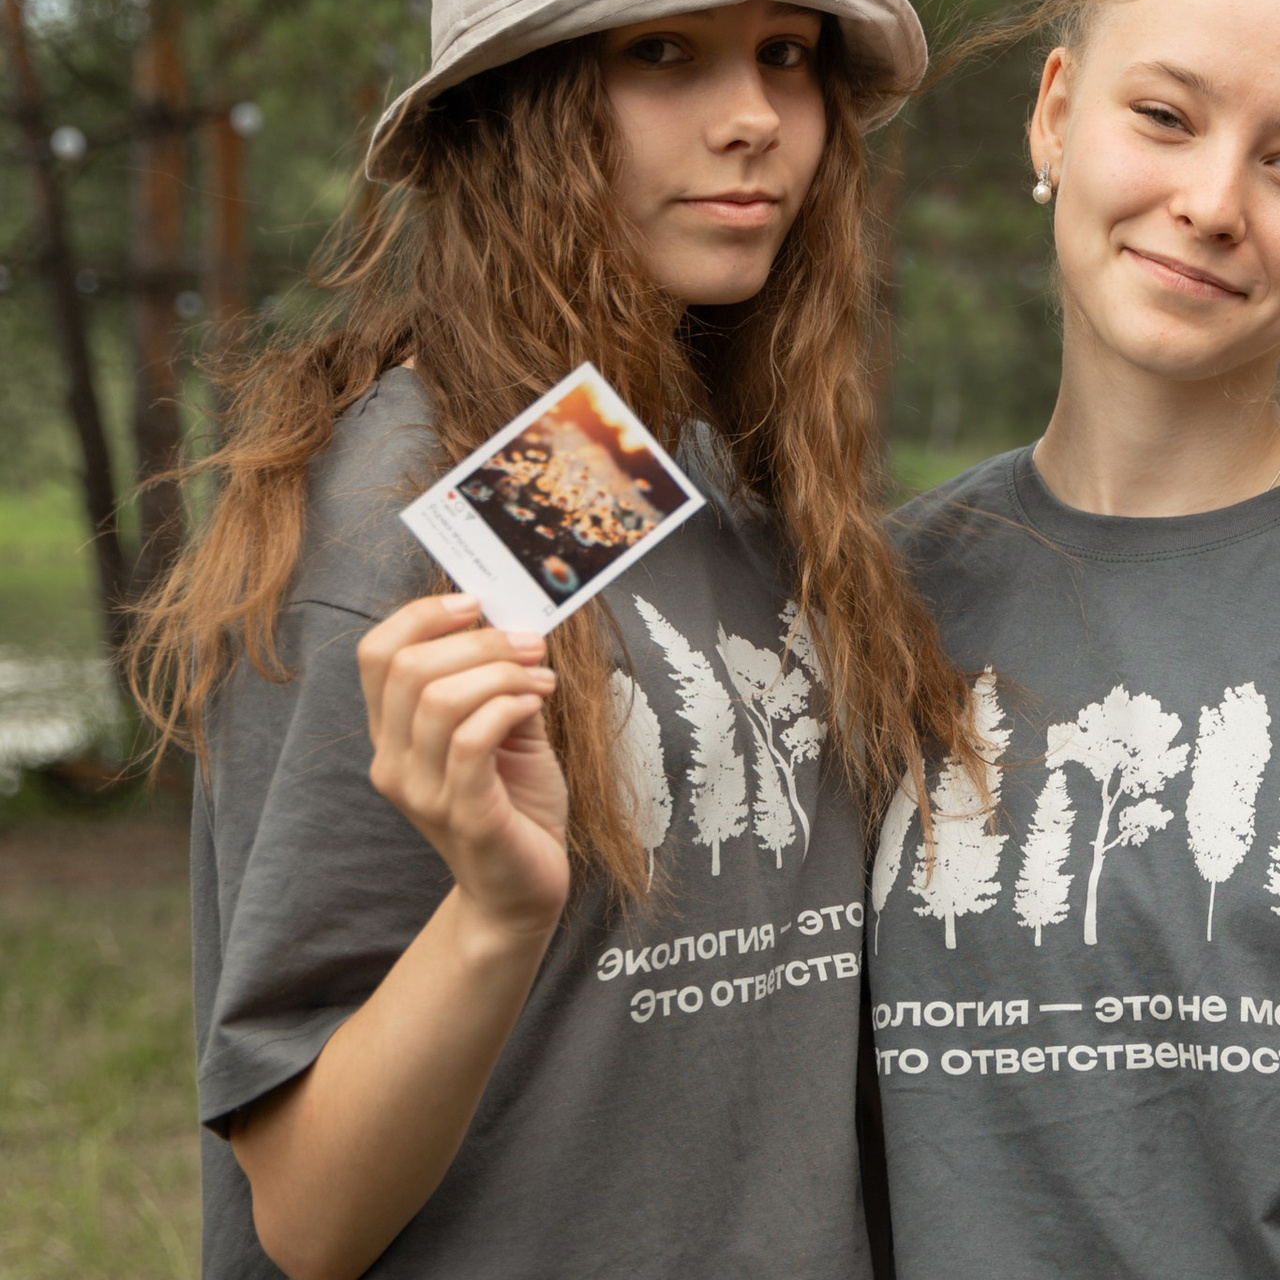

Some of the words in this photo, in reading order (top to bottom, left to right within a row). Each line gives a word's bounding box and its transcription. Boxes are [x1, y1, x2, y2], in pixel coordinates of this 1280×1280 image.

[596, 923, 776, 982] Экология
[797, 901, 865, 936] это
[630, 985, 704, 1024] Это
[710, 950, 863, 1008] ответств
[872, 999, 1030, 1031] ология
[1094, 994, 1172, 1024] это
[1178, 994, 1228, 1023] не
[875, 1046, 930, 1078] то
